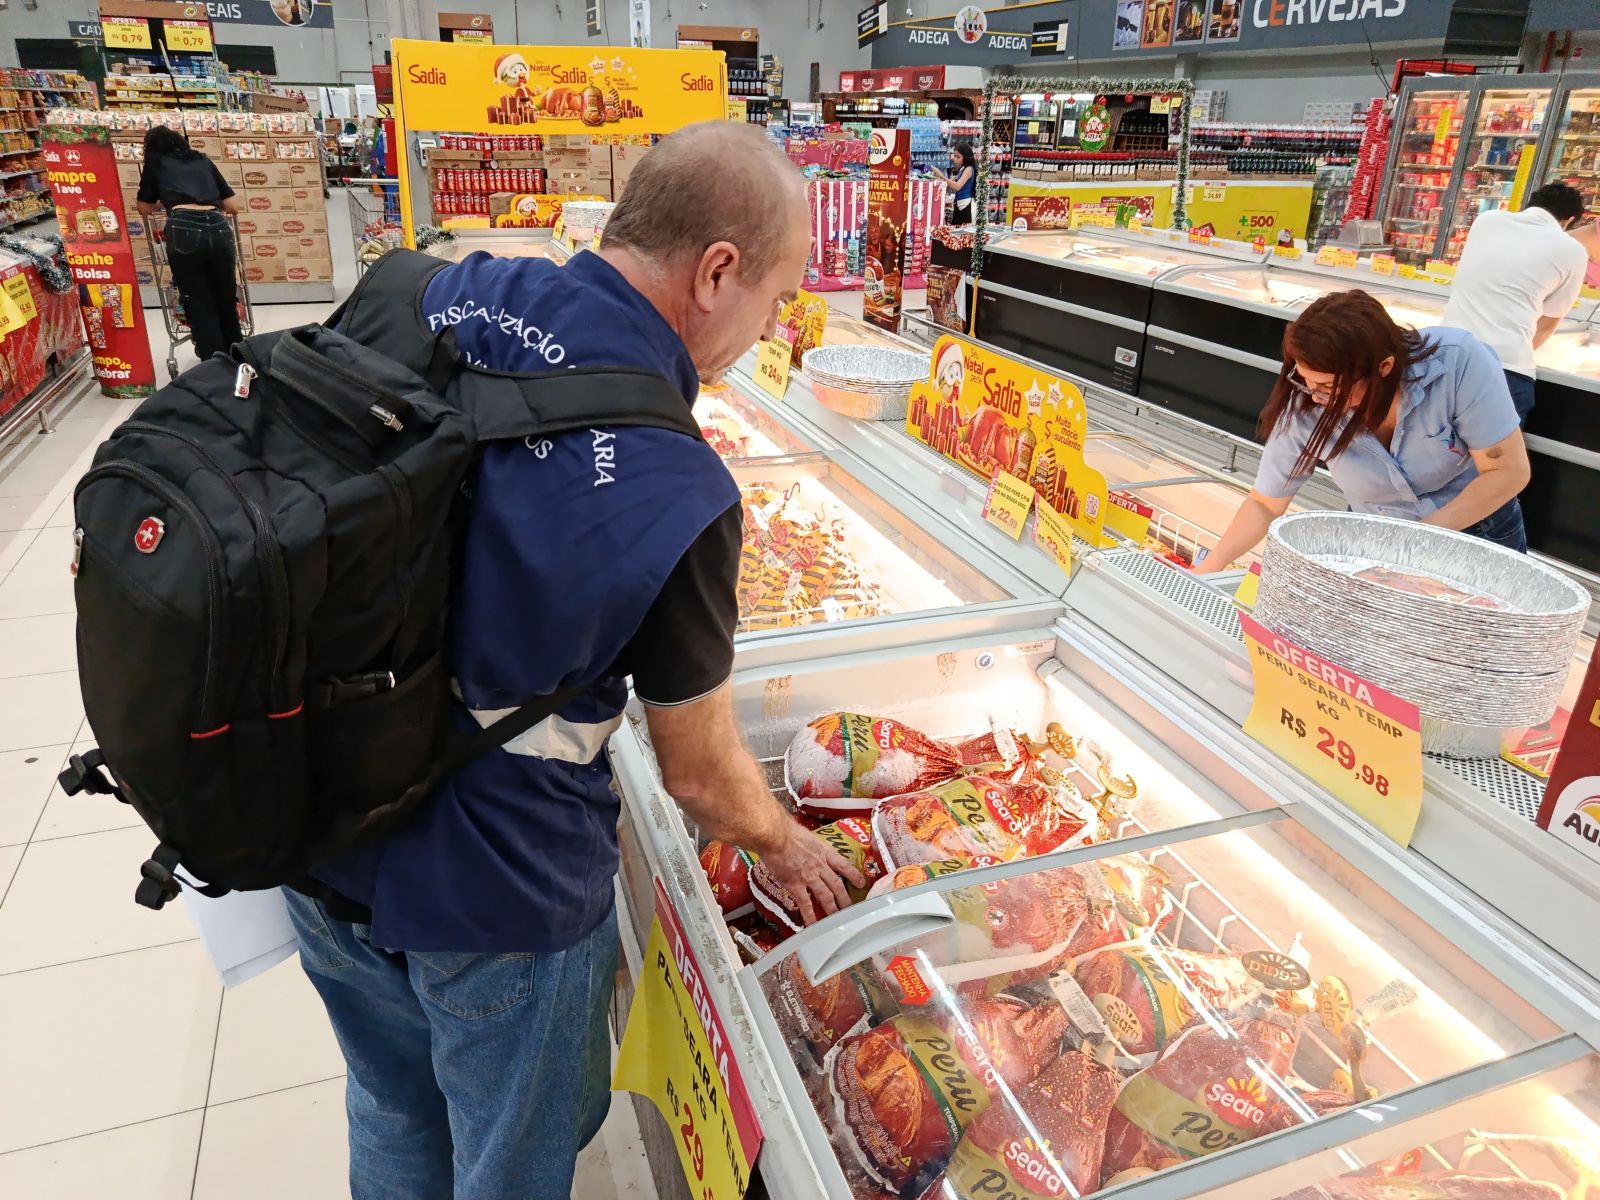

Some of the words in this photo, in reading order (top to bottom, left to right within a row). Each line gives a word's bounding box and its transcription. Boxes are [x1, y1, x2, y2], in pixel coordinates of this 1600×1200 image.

[1253, 0, 1406, 28] CERVEJAS
[121, 34, 143, 44] 0,79
[183, 37, 204, 47] 0,79
[908, 29, 950, 46] ADEGA
[988, 35, 1027, 51] ADEGA
[408, 64, 447, 86] Sadia
[529, 64, 551, 72] Natal
[550, 64, 587, 84] Sadia
[680, 72, 714, 92] Sadia
[48, 170, 97, 186] ompre
[61, 185, 83, 194] ave
[1250, 215, 1275, 228] 500
[66, 251, 114, 266] Ganhe
[76, 267, 112, 279] Bolsa
[427, 300, 566, 365] FISCALIZAÇÃO
[120, 362, 132, 370] de
[963, 356, 984, 375] Natal
[982, 367, 1022, 419] Sadia
[1055, 414, 1072, 429] Muito
[1060, 427, 1079, 440] macio
[1054, 433, 1081, 451] suculento
[1107, 491, 1139, 514] OFERTA
[1272, 638, 1376, 708] OFERTA
[1256, 645, 1294, 678] PERU
[1297, 671, 1352, 712] SEARA
[1354, 704, 1403, 739] TEMP
[1315, 699, 1340, 721] KG
[850, 714, 872, 753] Peru
[879, 720, 894, 749] Seara
[1279, 706, 1307, 739] R$
[1315, 725, 1390, 797] 29,98
[986, 789, 1021, 834] Seara
[816, 824, 854, 860] eru
[1562, 812, 1600, 847] Au
[893, 964, 917, 998] FECHADO
[901, 959, 927, 997] MANTENHA
[672, 933, 731, 1099] OFERTA
[1102, 1003, 1140, 1041] Seara
[914, 1036, 977, 1112] Peru
[666, 1076, 680, 1118] R$
[682, 1016, 718, 1115] SEARA
[720, 1107, 746, 1197] TEMP
[691, 1072, 707, 1122] KG
[1206, 1082, 1265, 1126] Seara
[1005, 1140, 1062, 1194] Seara
